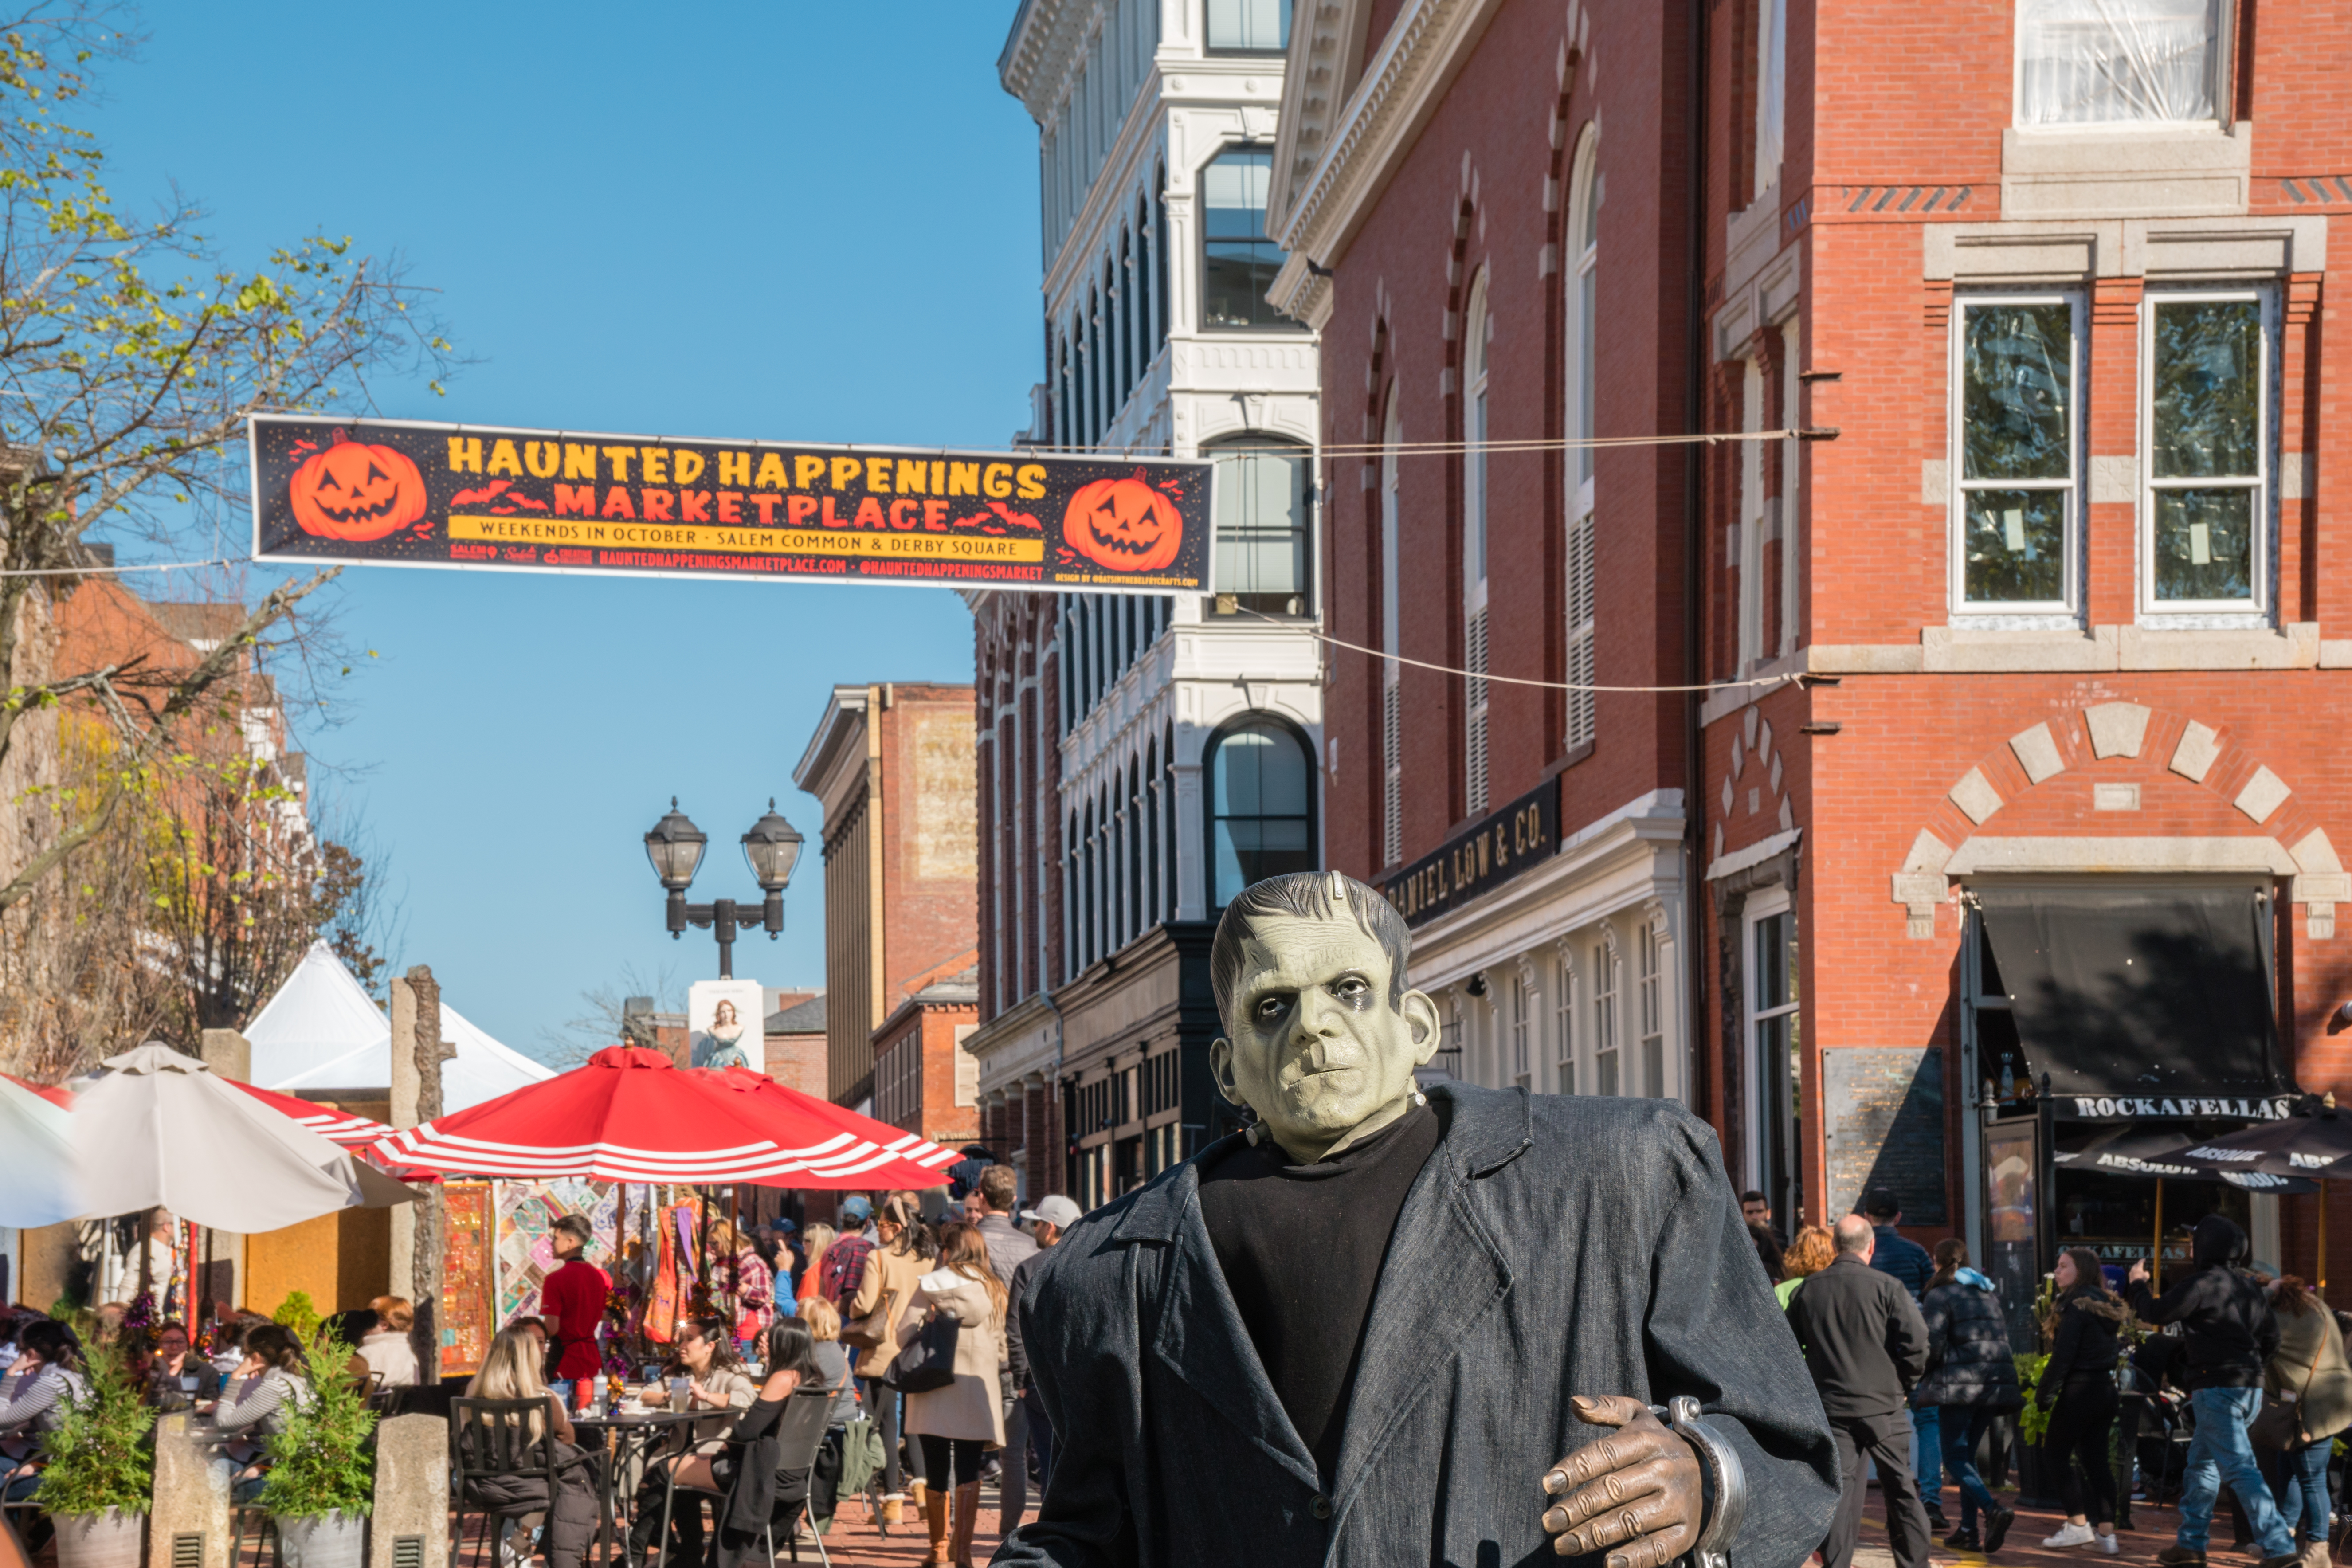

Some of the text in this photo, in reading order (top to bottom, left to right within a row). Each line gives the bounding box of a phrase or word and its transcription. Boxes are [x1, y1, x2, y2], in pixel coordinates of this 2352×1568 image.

[447, 436, 1047, 499] HAUNTED HAPPENINGS
[554, 483, 950, 531] MARKETPLACE
[450, 544, 486, 554] SALEM
[480, 522, 1017, 556] WEEKENDS IN OCTOBER SALEM COMMON & DERBY SQUARE
[599, 550, 846, 574] HAUNTEDHAPPENINGSMARKETPLACE.COM
[860, 560, 1044, 581] @HAUNTEDHAPPENINGSMARKET
[1055, 573, 1080, 582] DESIGN
[1082, 574, 1090, 583] BY
[1454, 831, 1490, 891] LOW
[1496, 822, 1508, 867] &
[1515, 801, 1547, 856] CO.
[2075, 1098, 2290, 1120] ROCKAFELLAS
